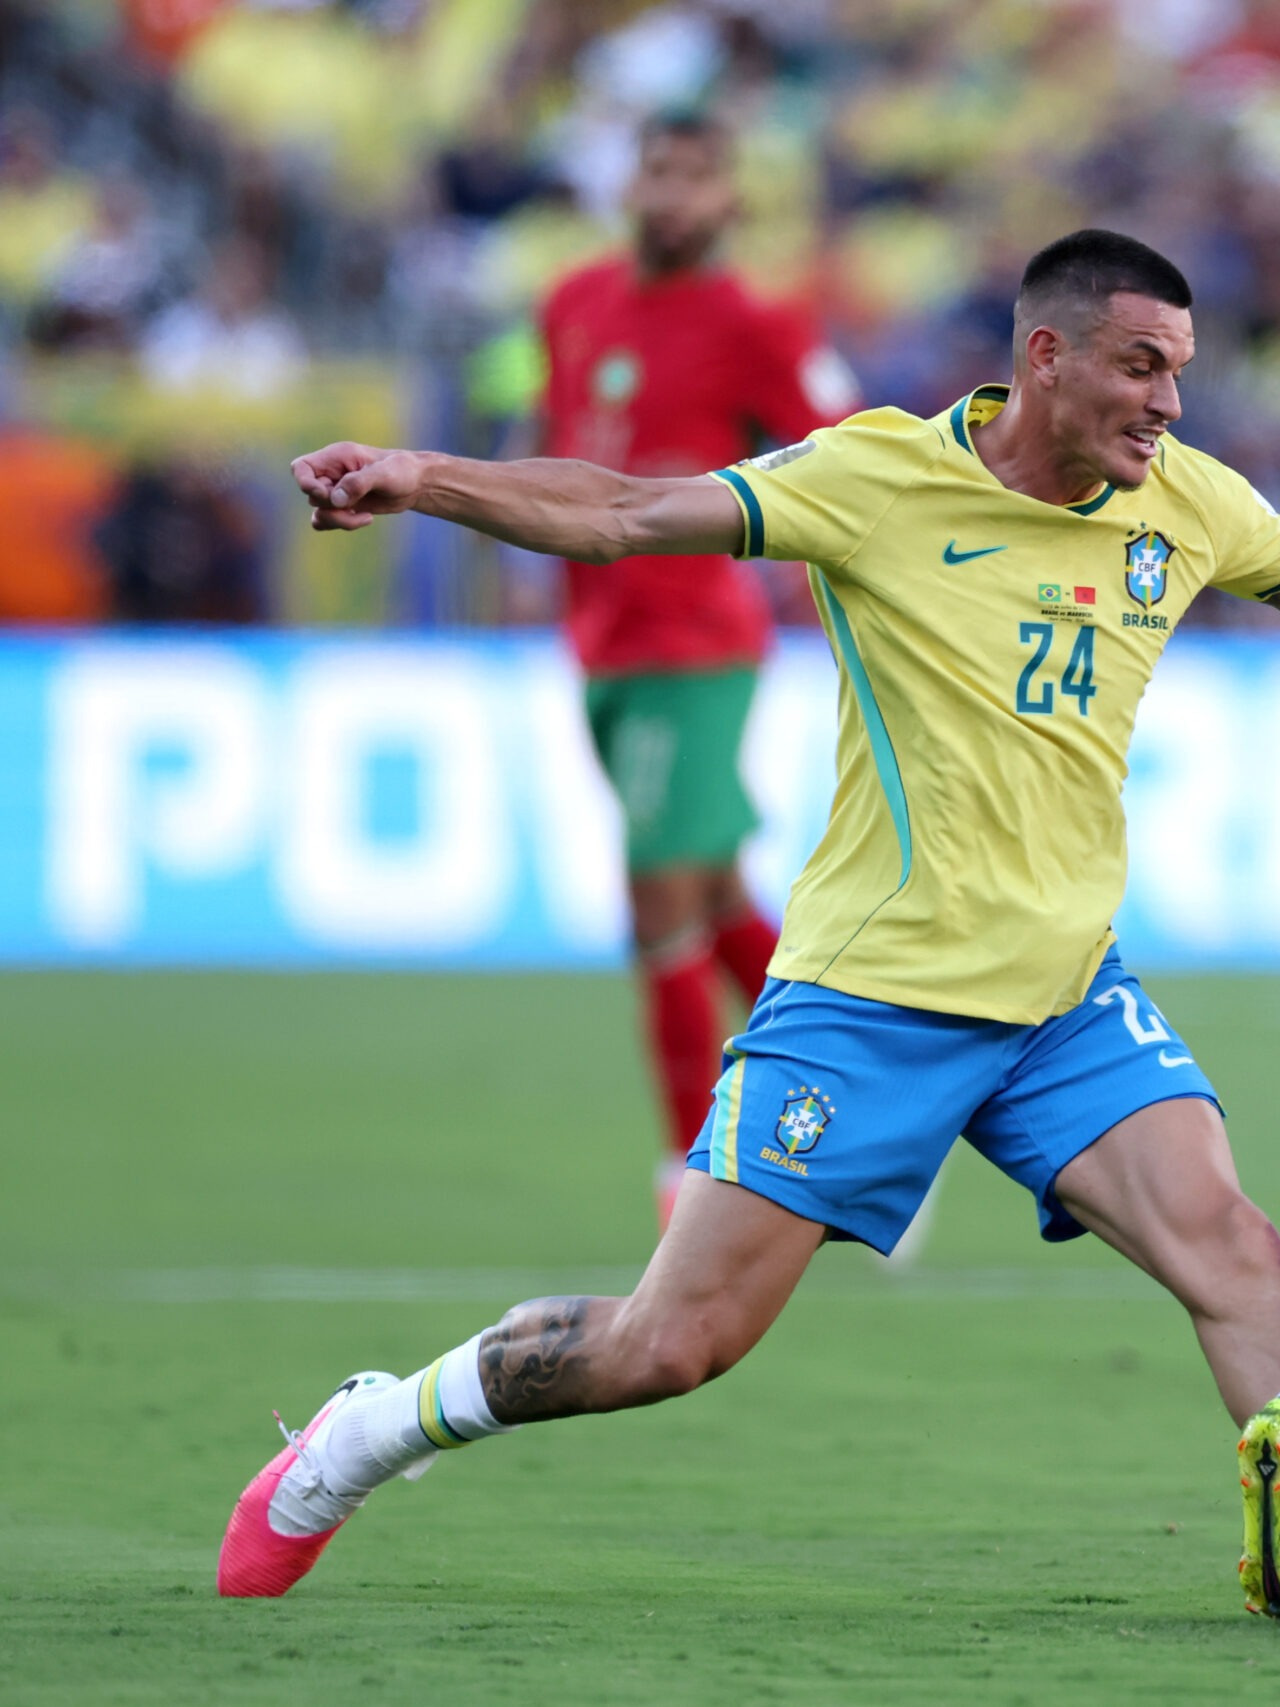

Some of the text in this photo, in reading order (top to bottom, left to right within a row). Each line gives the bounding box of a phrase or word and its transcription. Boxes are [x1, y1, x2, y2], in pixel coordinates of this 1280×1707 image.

[1138, 562, 1156, 573] CBF
[1122, 612, 1168, 630] BRASIL
[1016, 622, 1098, 716] 24
[1092, 984, 1170, 1046] 2
[792, 1117, 811, 1130] CBF
[759, 1146, 809, 1176] BRASIL
